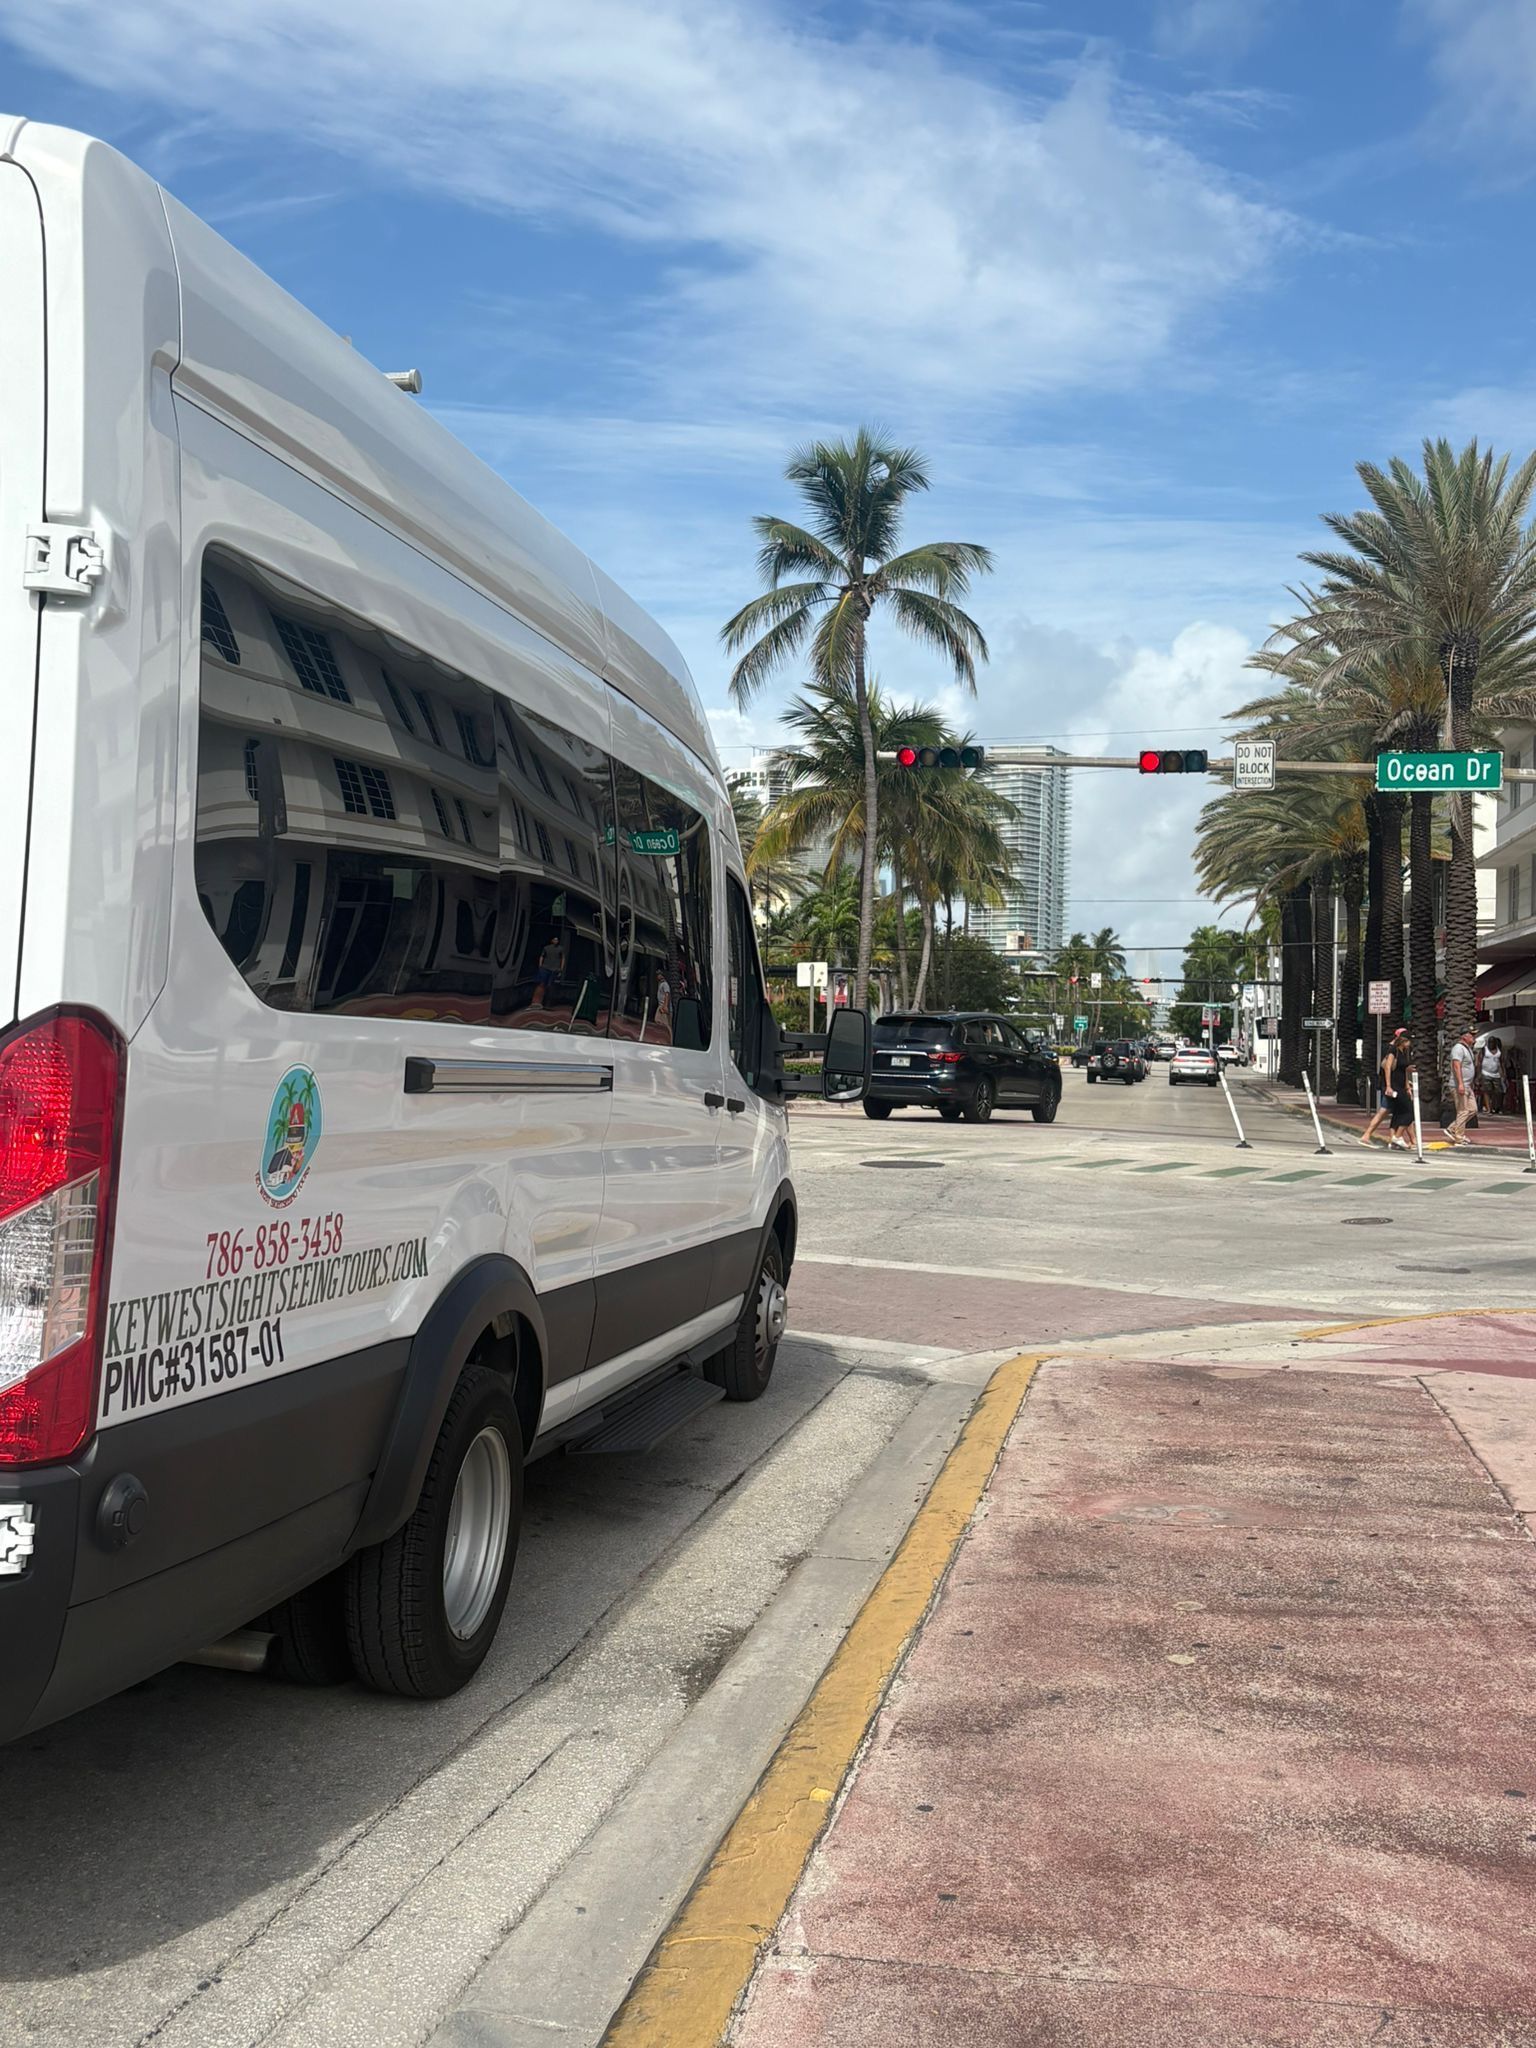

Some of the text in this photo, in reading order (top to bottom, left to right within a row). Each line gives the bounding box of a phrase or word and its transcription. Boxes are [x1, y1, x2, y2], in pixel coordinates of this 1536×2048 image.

[1237, 746, 1272, 758] DO NOT
[1239, 762, 1270, 774] BLOCK
[1387, 758, 1492, 782] Ocean Dr
[206, 1212, 344, 1279] 786-858-3458
[105, 1237, 429, 1359] KEYWESTSIGHTSEEINGTOURS.COM
[103, 1317, 285, 1417] PMC#31587-01
